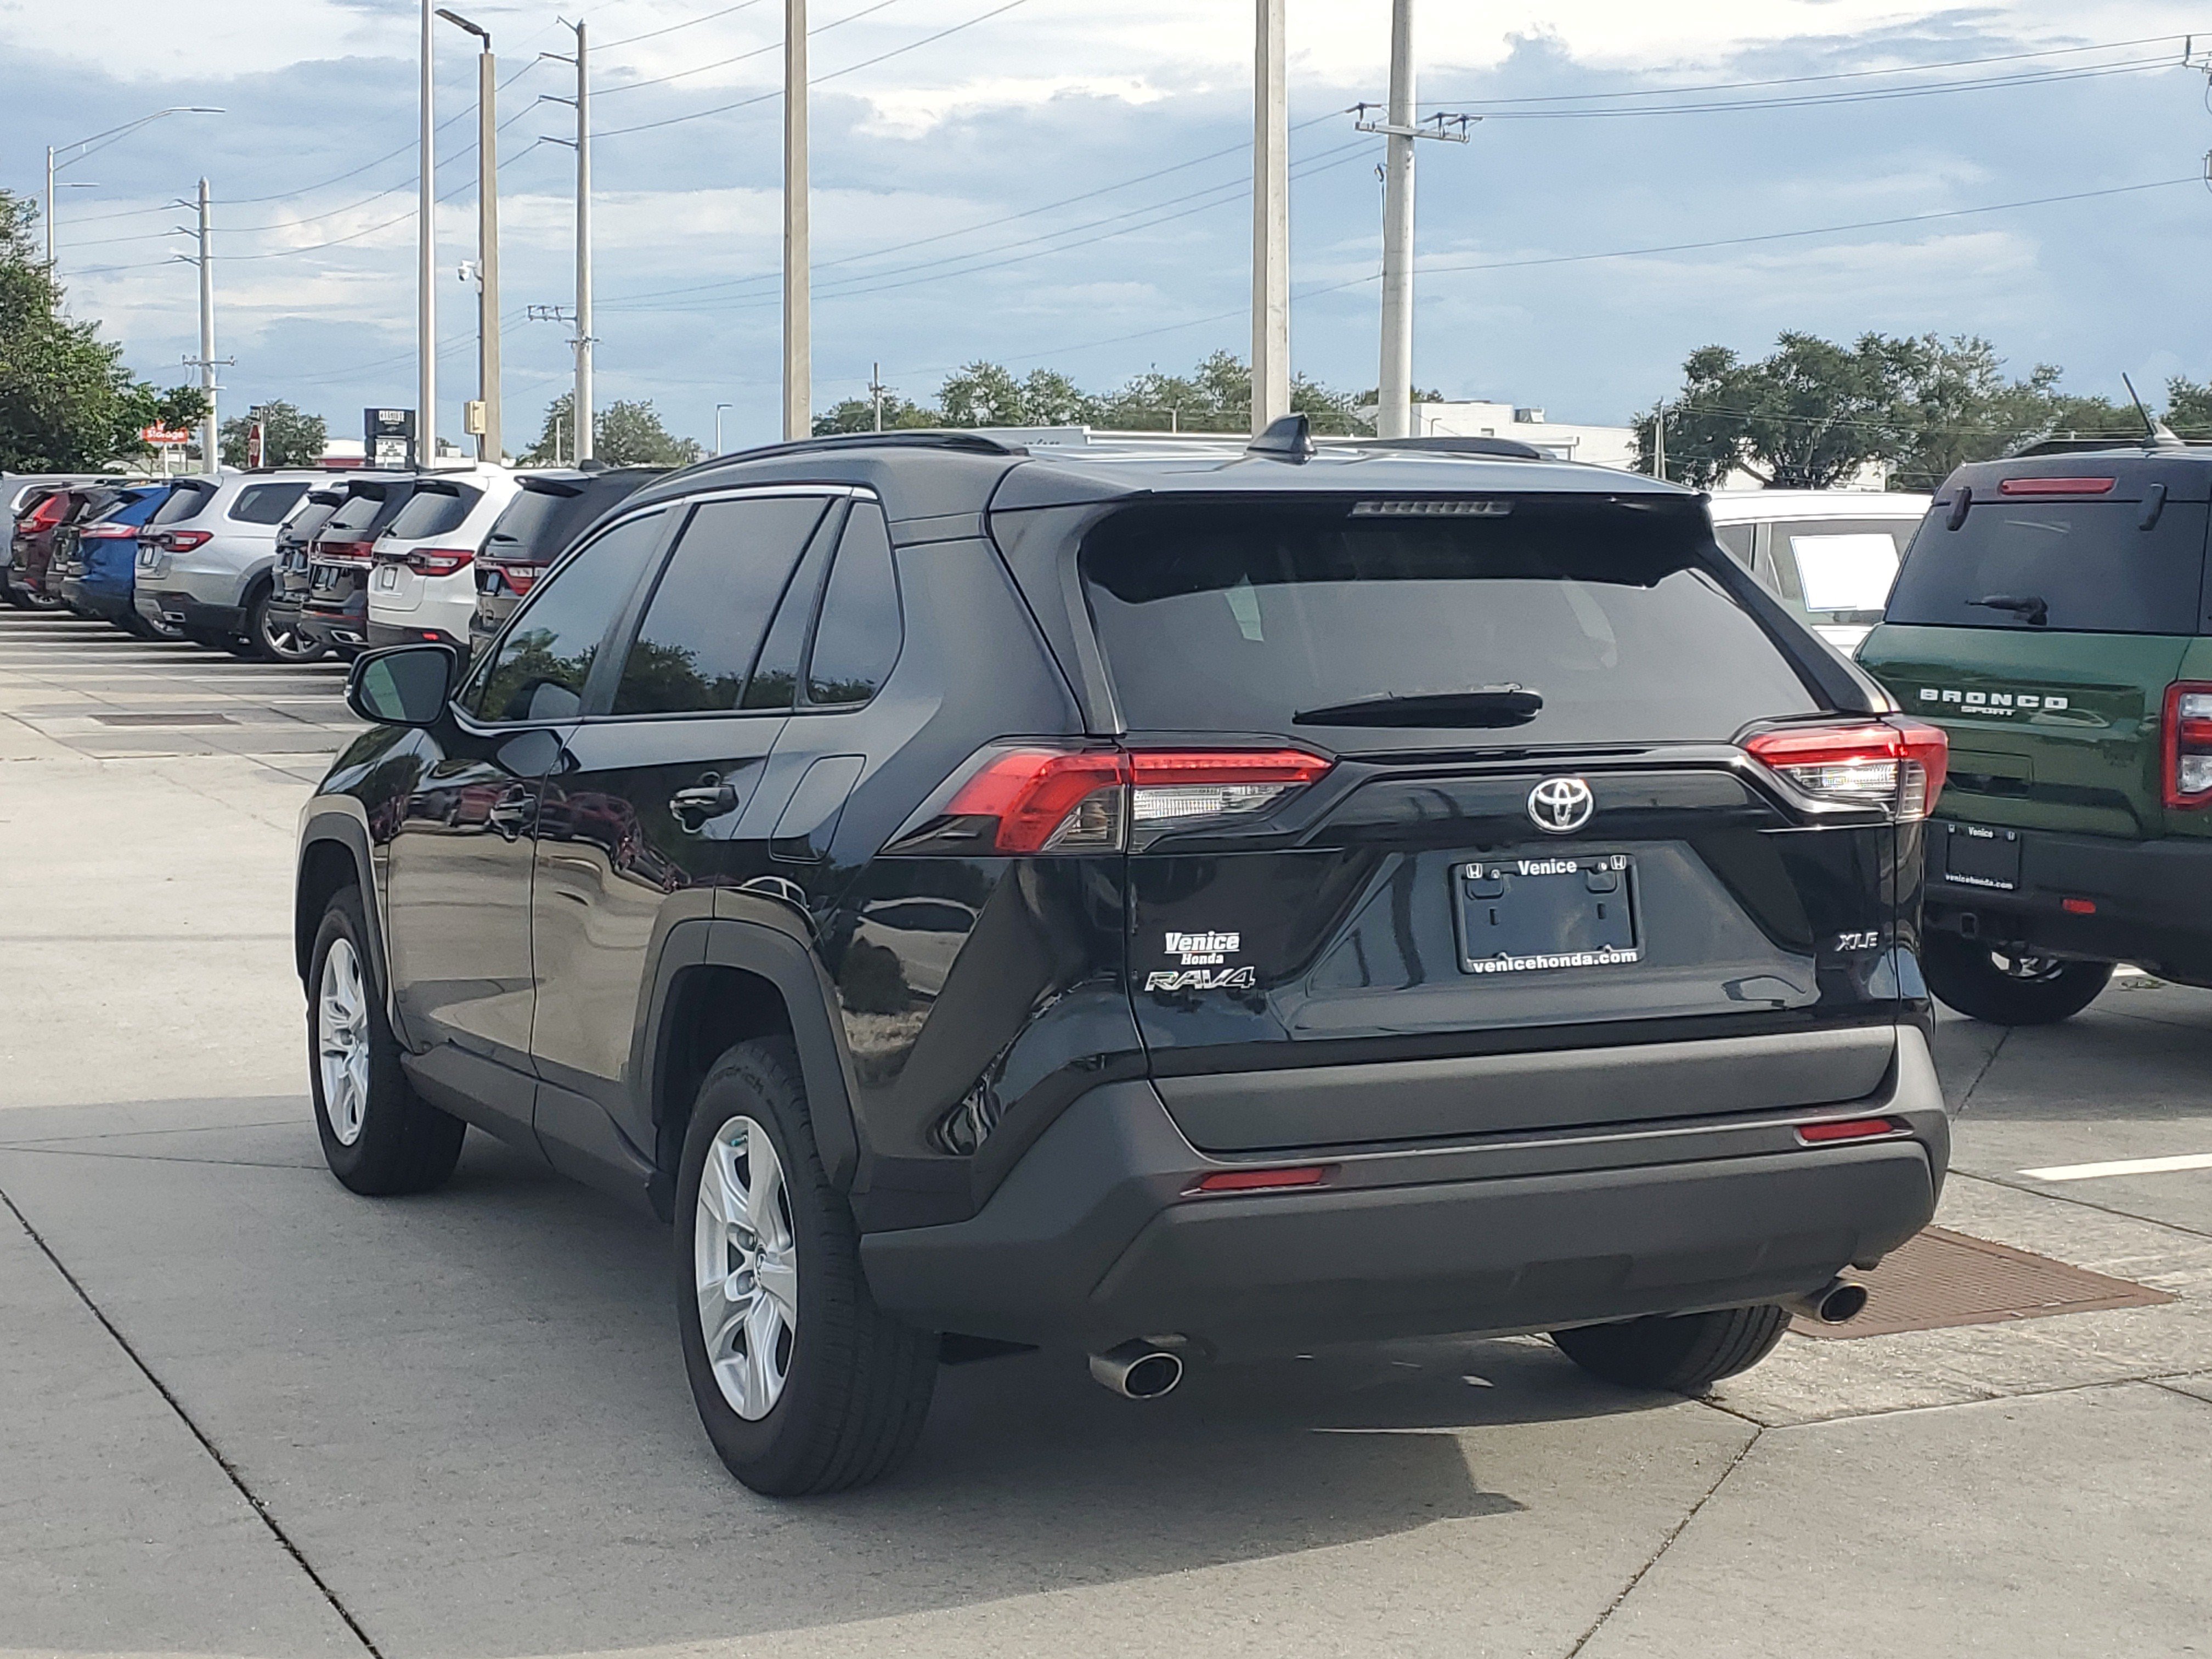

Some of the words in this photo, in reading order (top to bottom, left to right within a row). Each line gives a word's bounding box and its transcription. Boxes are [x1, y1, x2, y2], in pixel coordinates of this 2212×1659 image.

[1920, 689, 2068, 709] BRONCO
[1961, 706, 2016, 716] SPORT
[1968, 826, 1994, 838] Venice
[1518, 858, 1577, 876] Venice
[1165, 930, 1240, 951] Venice
[1835, 932, 1879, 952] XLE
[1180, 953, 1224, 965] Honda
[1473, 950, 1637, 973] venicehonda.com
[1144, 966, 1256, 991] RAV4
